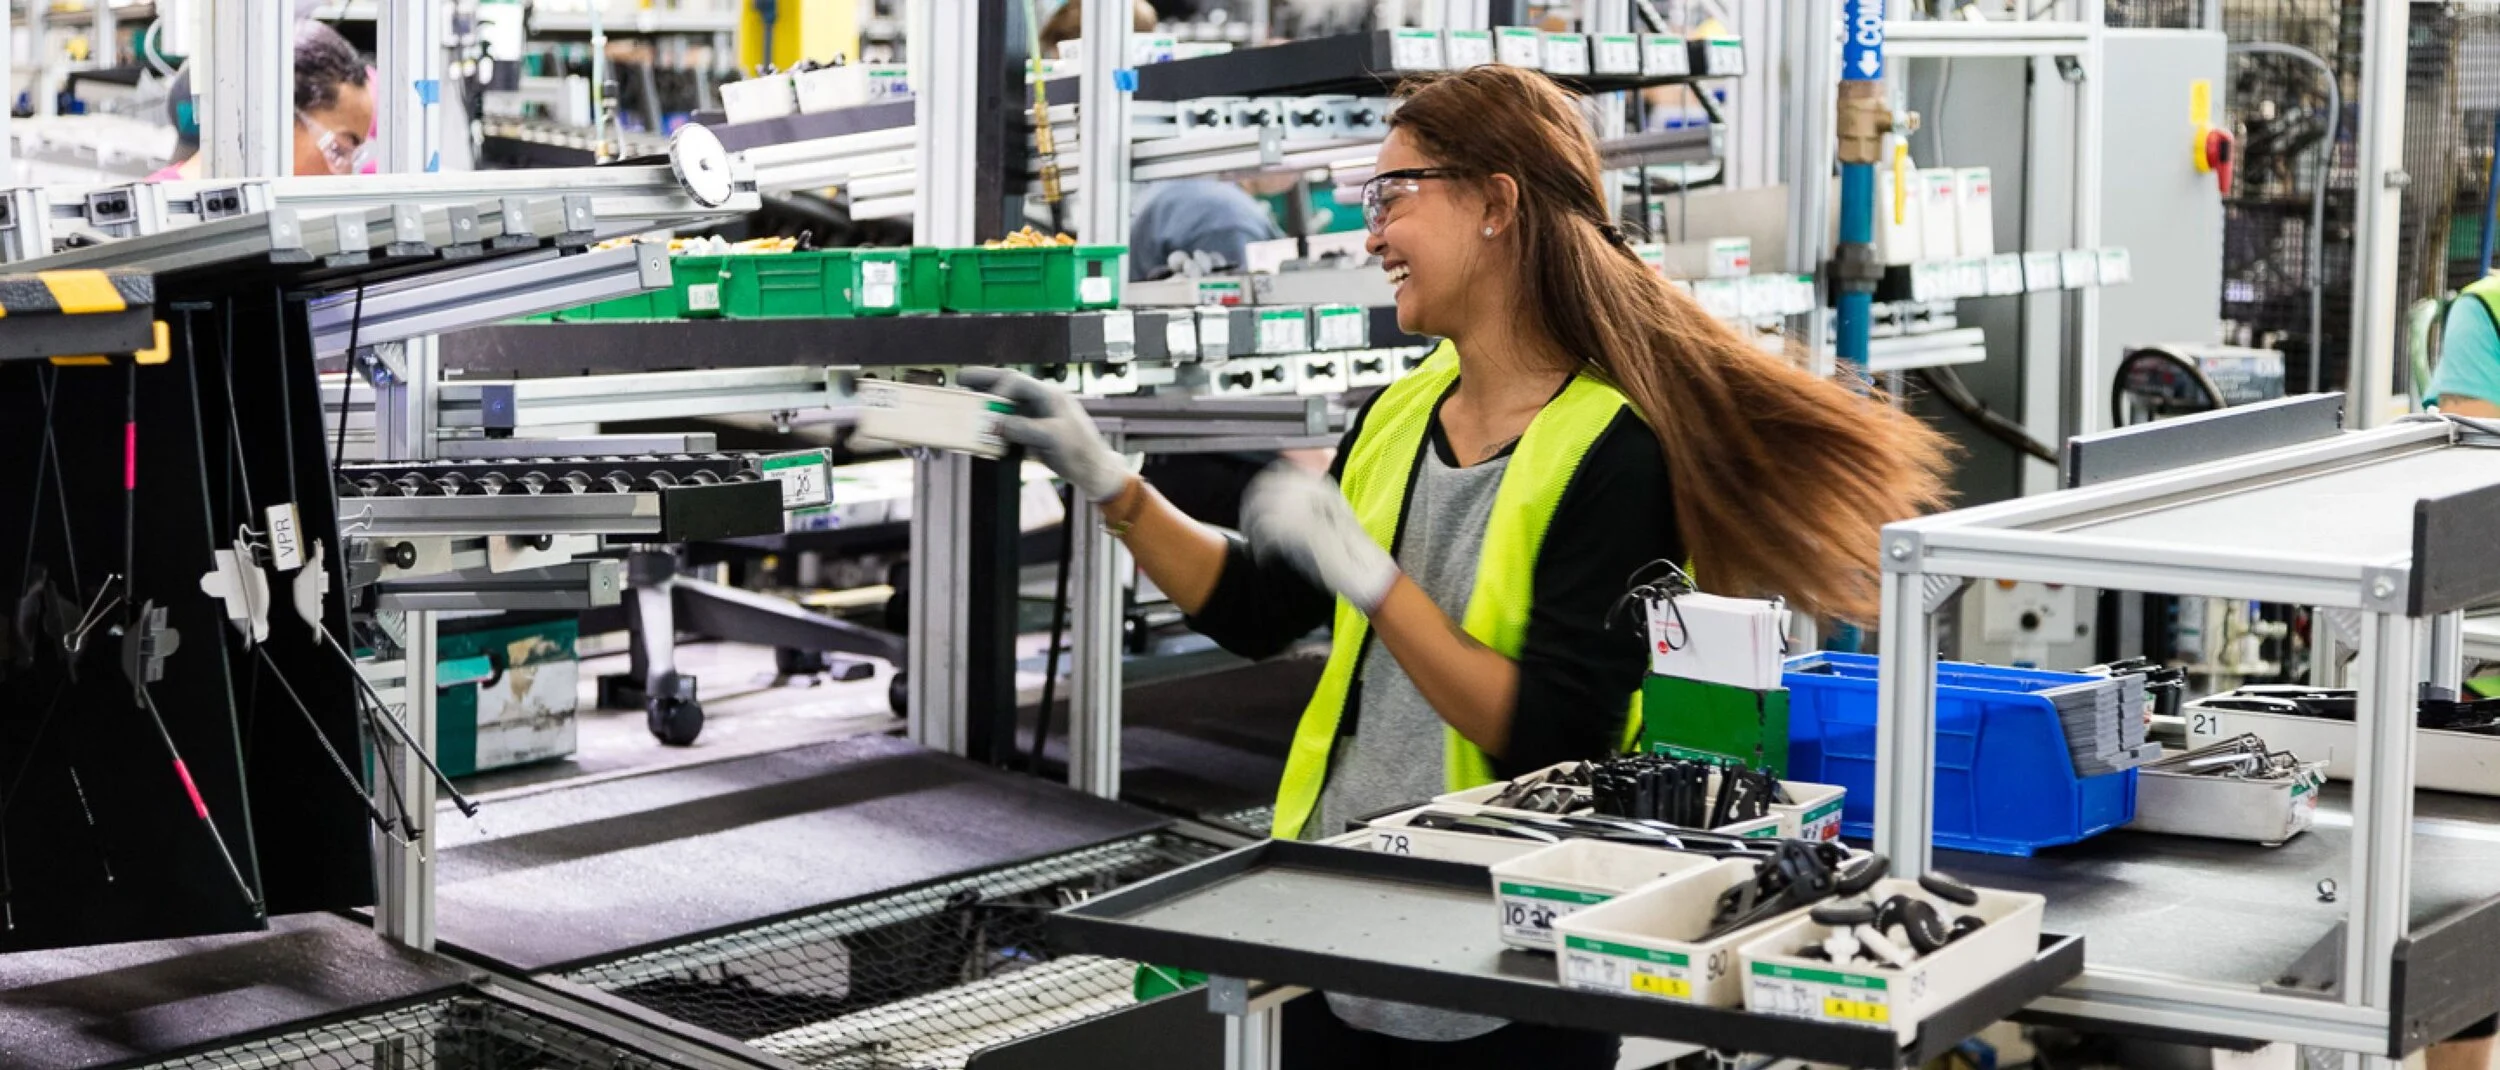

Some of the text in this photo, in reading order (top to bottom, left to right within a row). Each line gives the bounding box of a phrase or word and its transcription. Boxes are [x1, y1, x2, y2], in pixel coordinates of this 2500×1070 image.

[276, 518, 294, 558] VPR
[2193, 714, 2216, 735] 21
[1379, 834, 1409, 854] 78
[1707, 950, 1728, 981] 90
